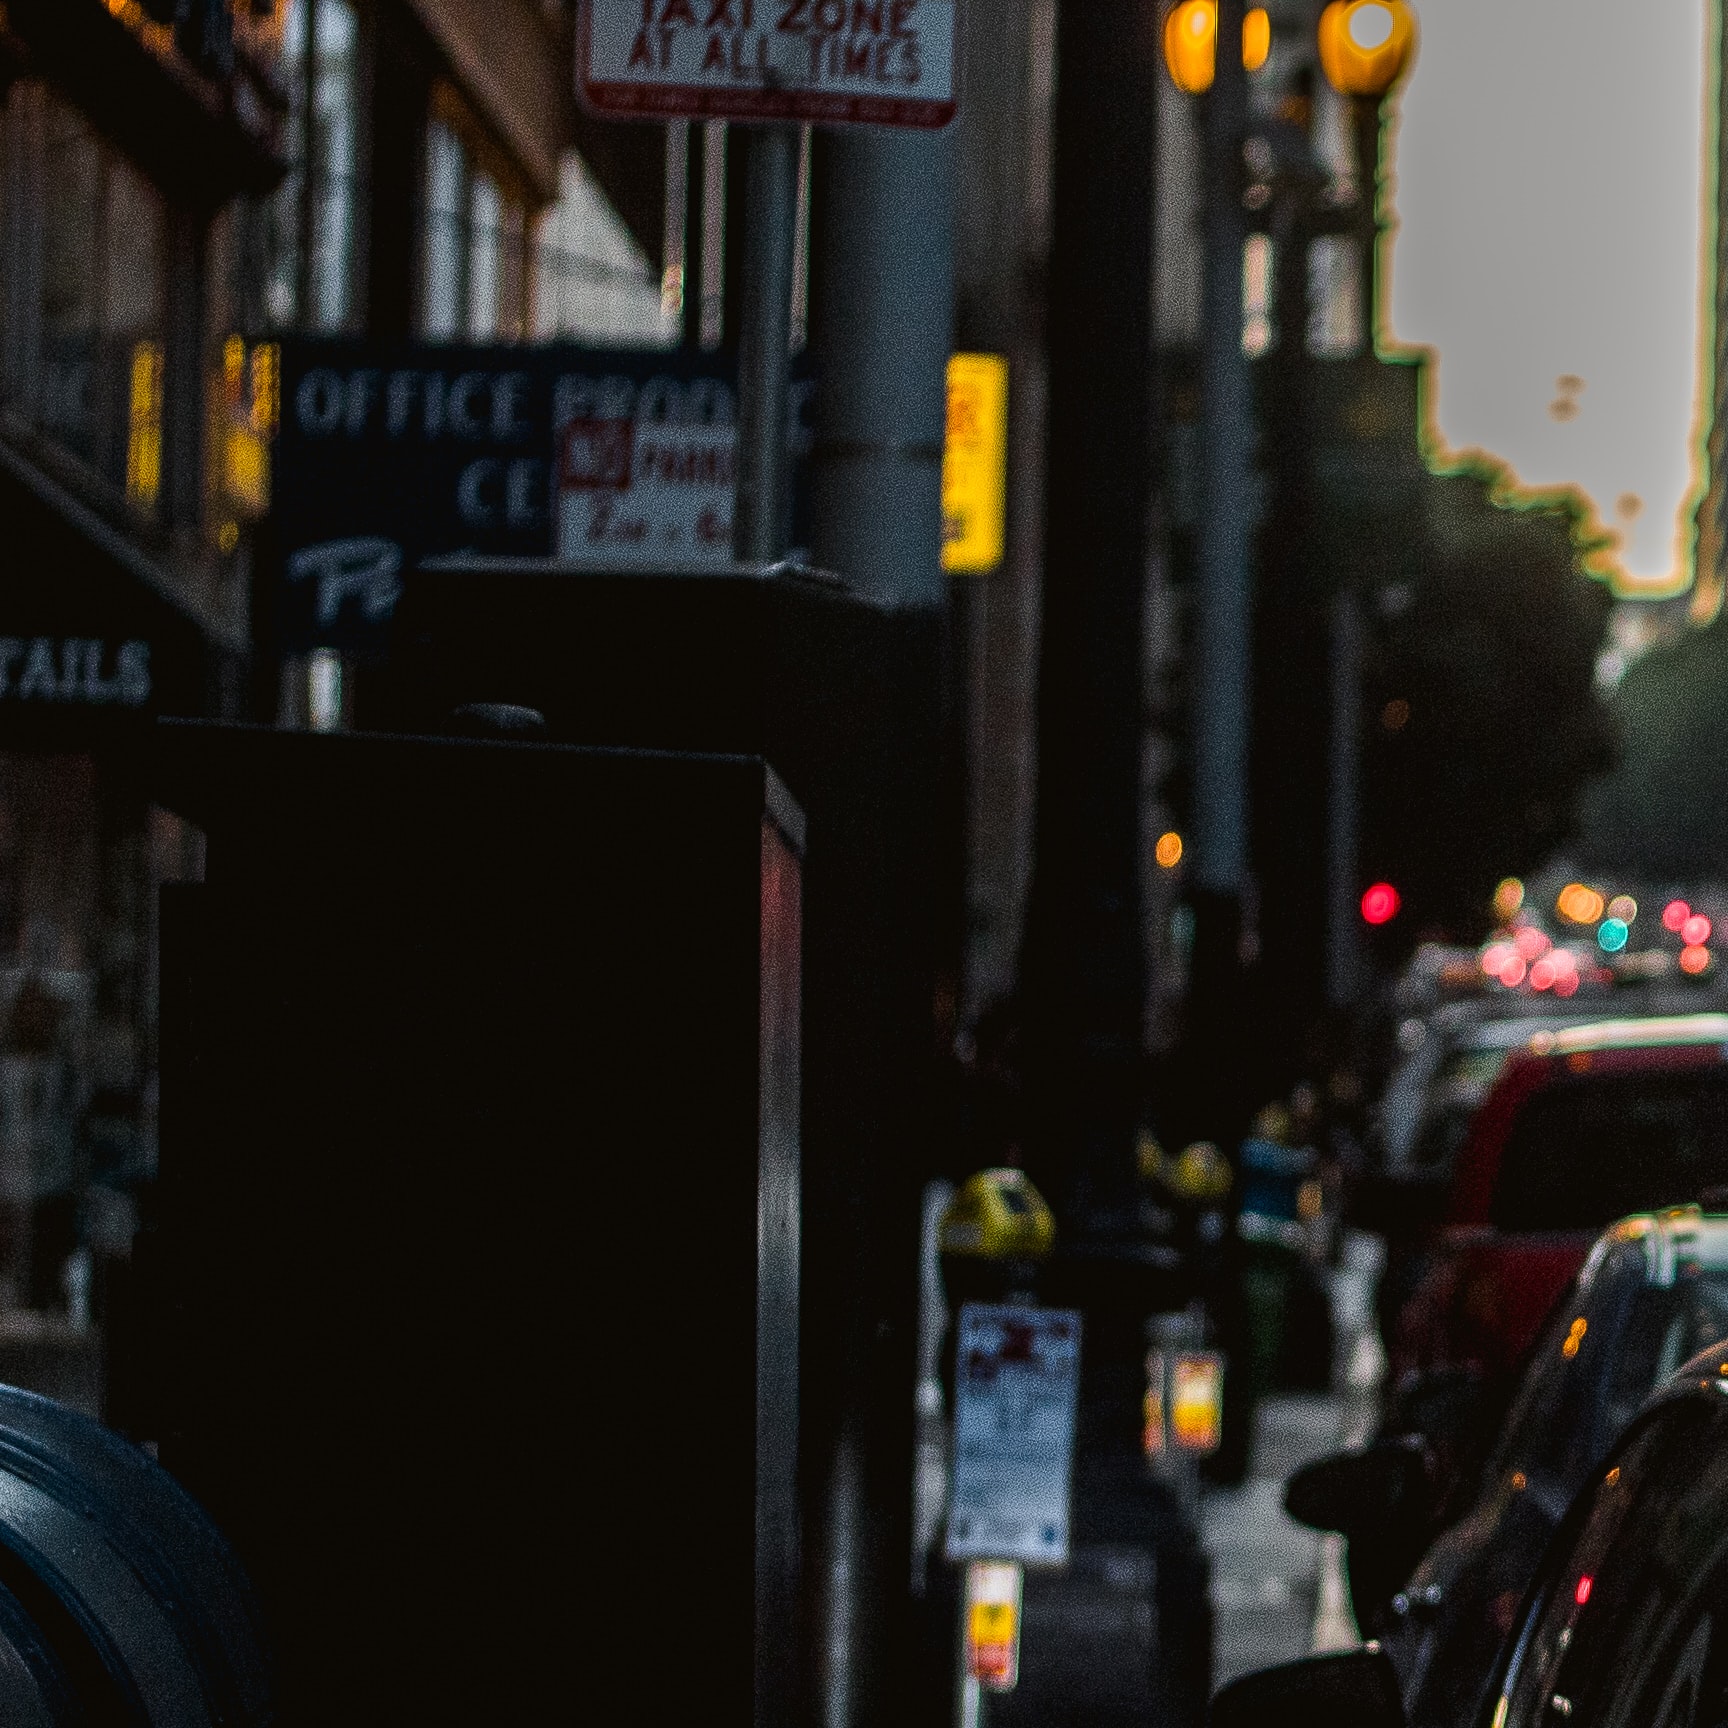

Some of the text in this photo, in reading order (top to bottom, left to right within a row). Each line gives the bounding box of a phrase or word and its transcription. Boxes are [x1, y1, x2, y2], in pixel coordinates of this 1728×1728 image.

[775, 0, 917, 38] ZONE
[629, 28, 922, 84] AT ALL TIMES
[295, 367, 528, 438] OFFICE
